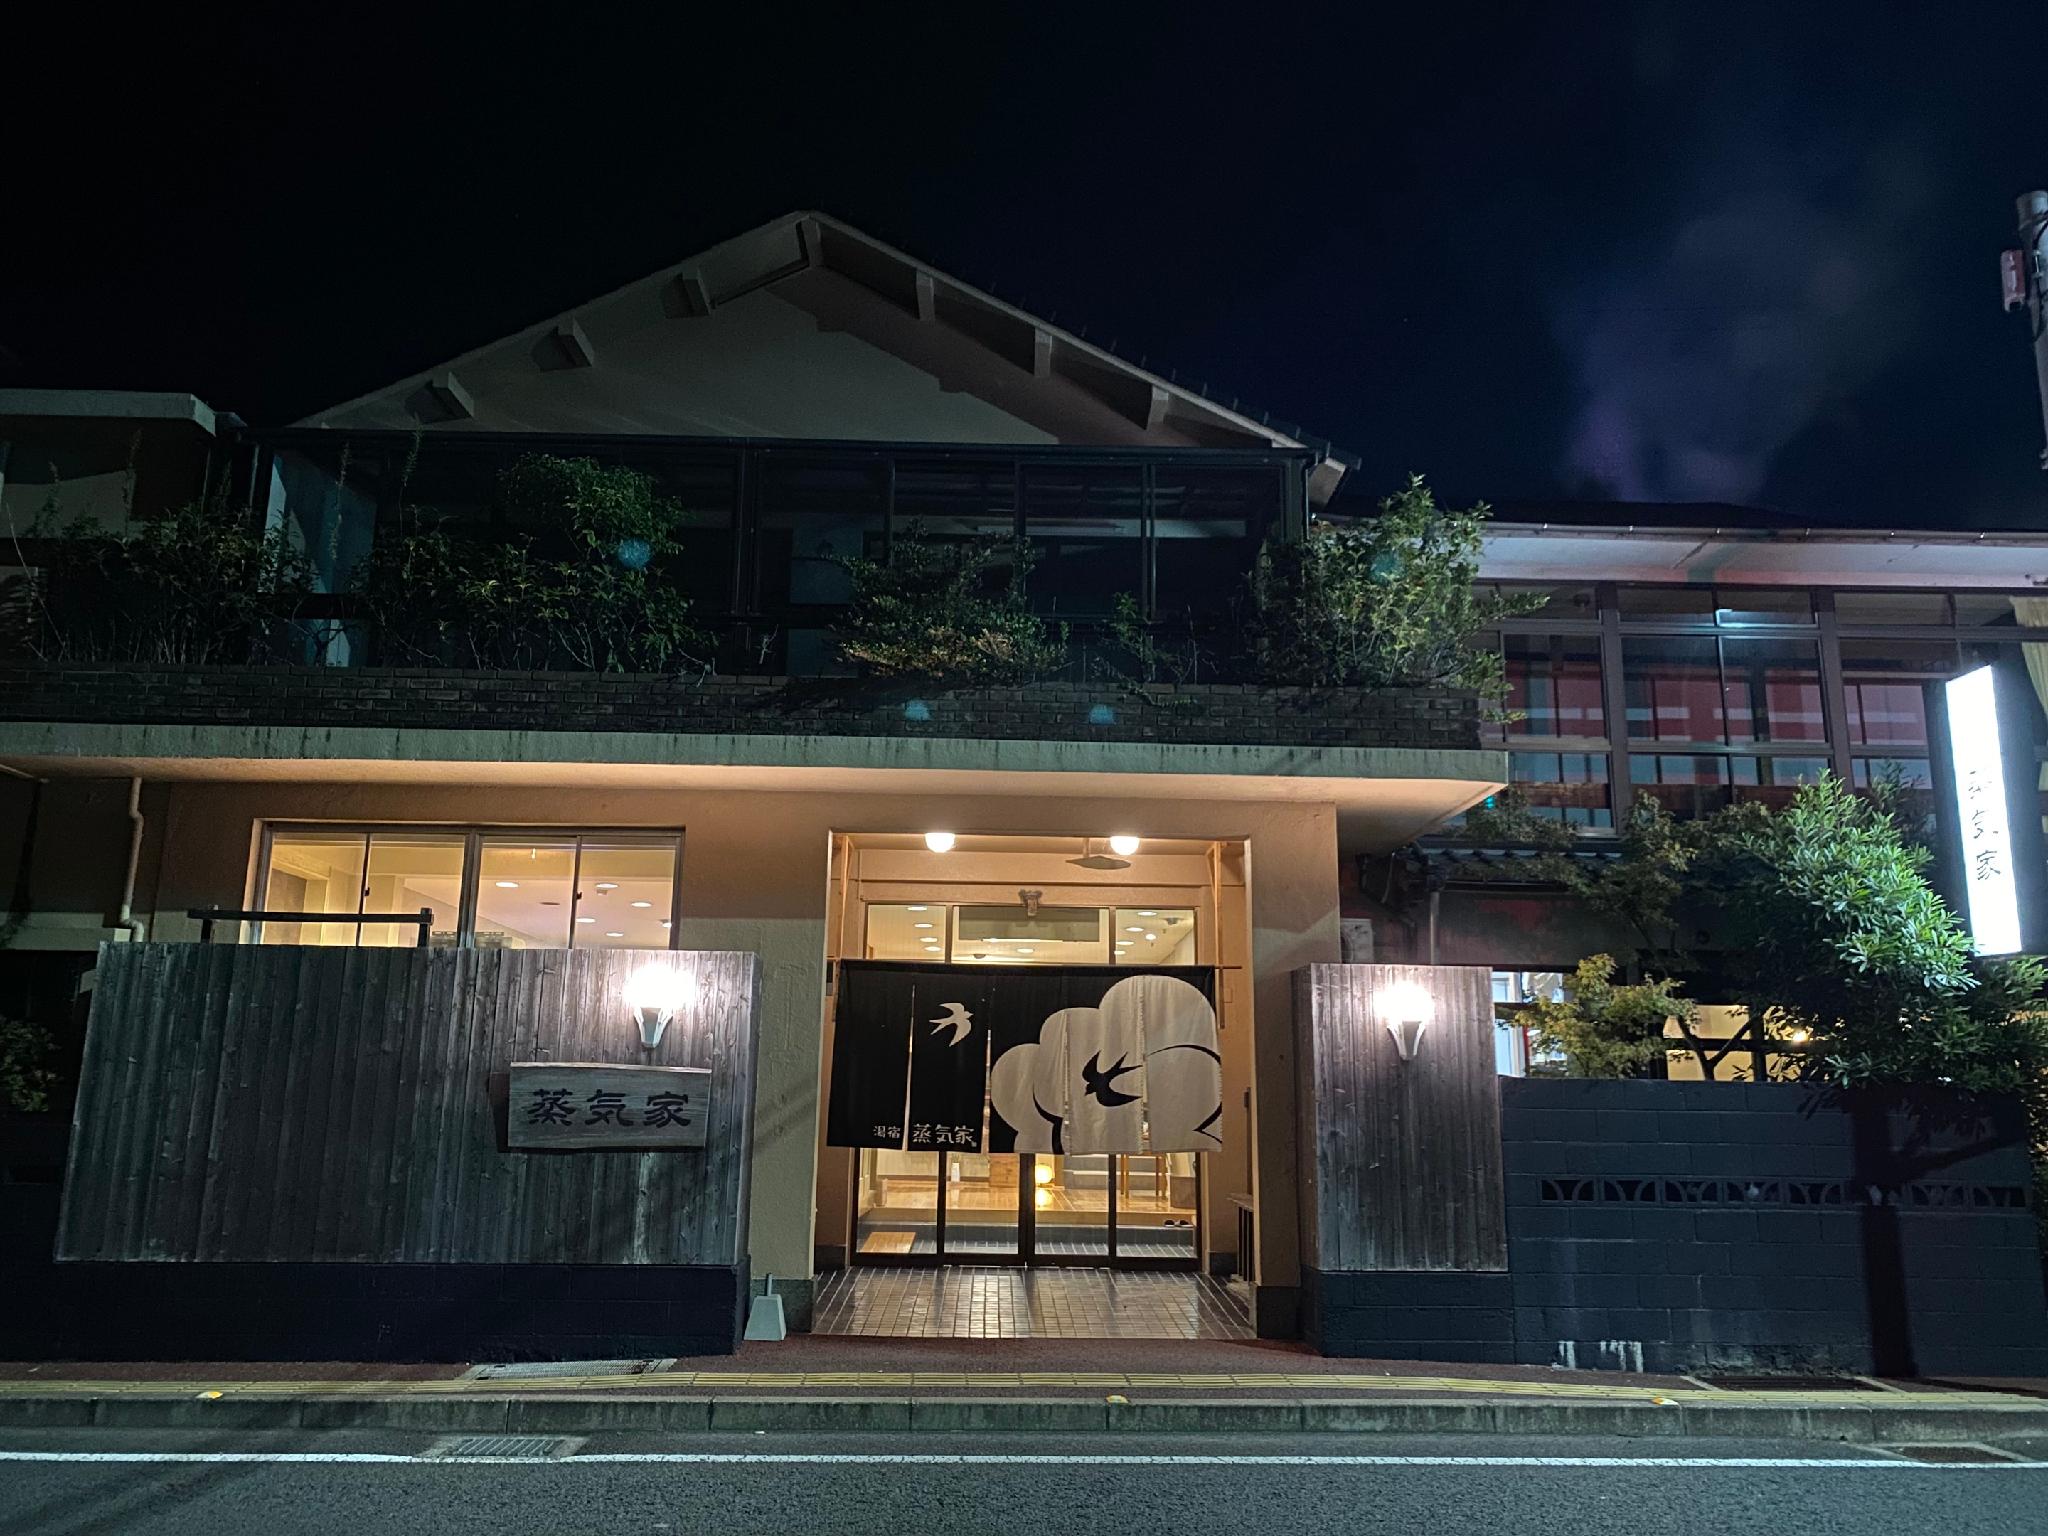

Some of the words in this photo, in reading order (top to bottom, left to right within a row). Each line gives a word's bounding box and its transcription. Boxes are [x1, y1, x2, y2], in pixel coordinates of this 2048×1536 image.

[526, 1087, 692, 1129] 蒸気家
[912, 1123, 975, 1144] 蒸気家
